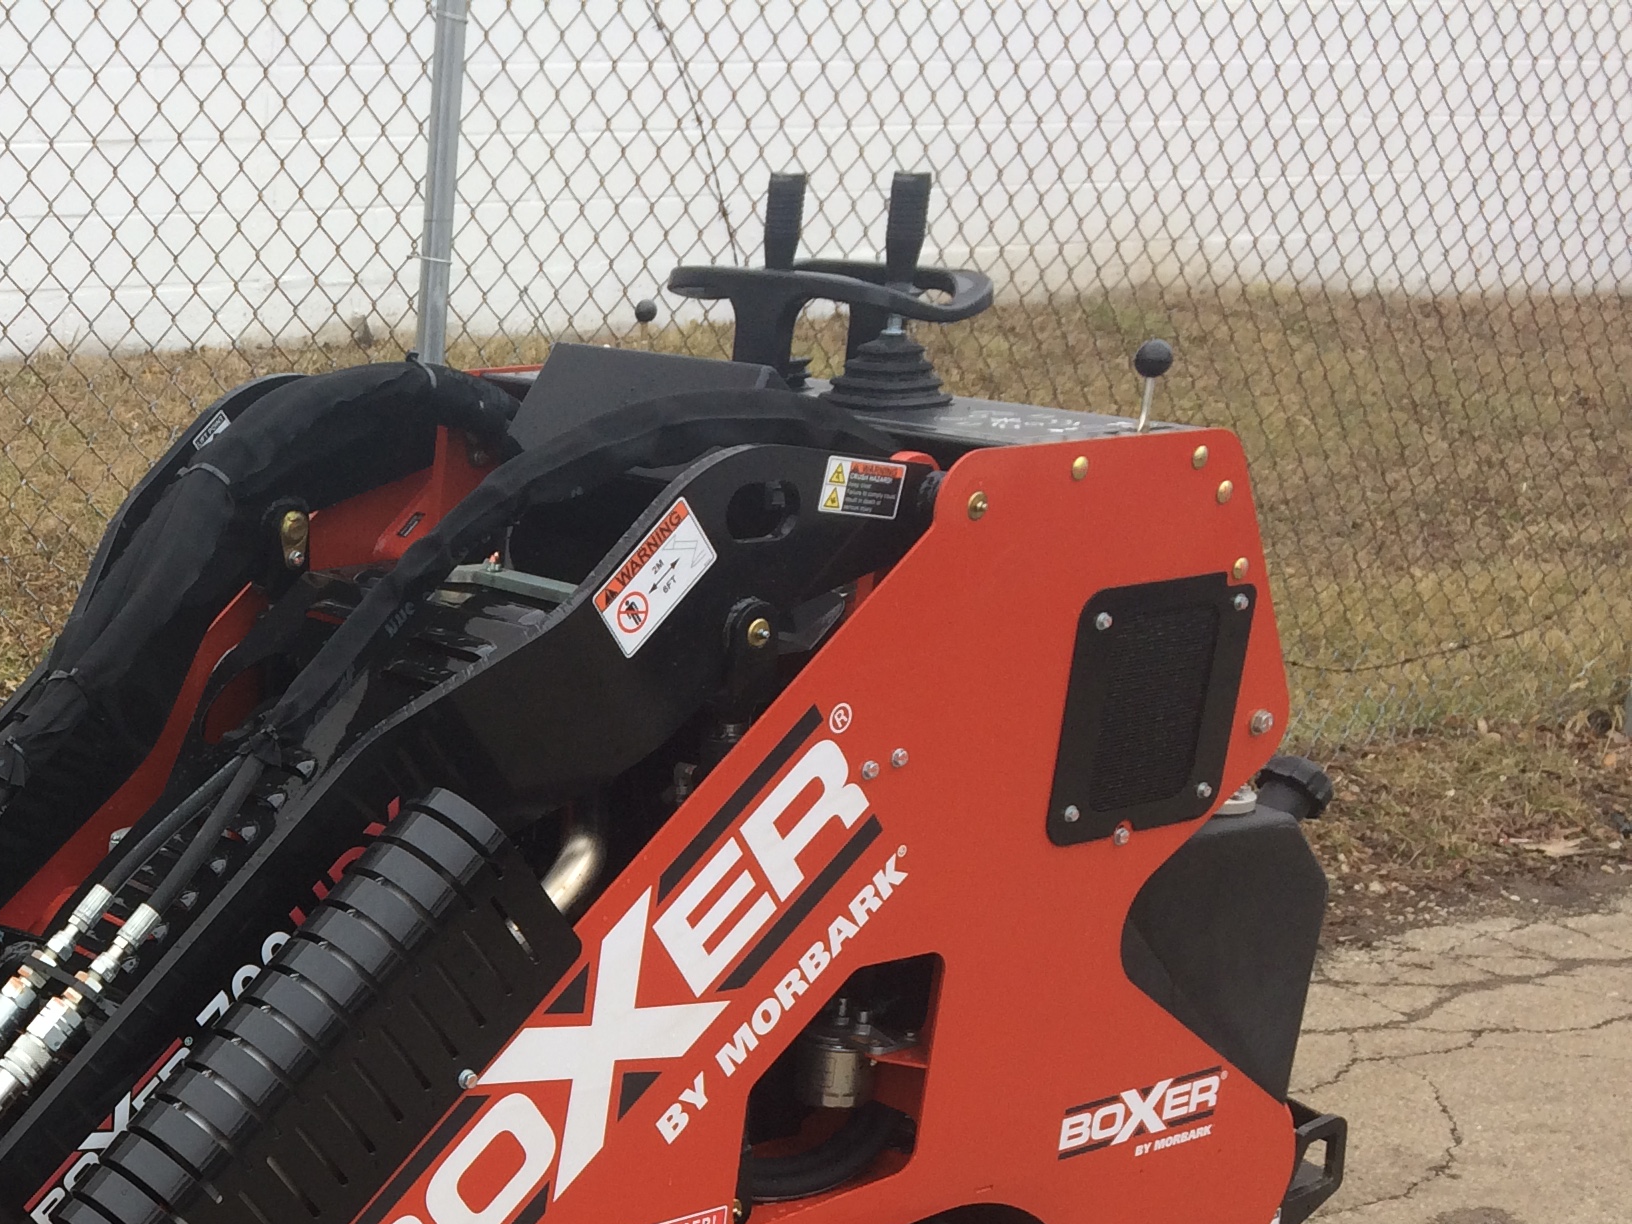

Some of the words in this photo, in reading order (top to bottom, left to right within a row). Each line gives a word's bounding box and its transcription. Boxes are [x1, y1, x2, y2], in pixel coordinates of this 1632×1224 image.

[615, 510, 681, 586] WARNING
[651, 559, 664, 575] 2M
[655, 1071, 709, 1145] BY
[1134, 1143, 1152, 1157] BY
[1153, 1124, 1213, 1151] MORBARK
